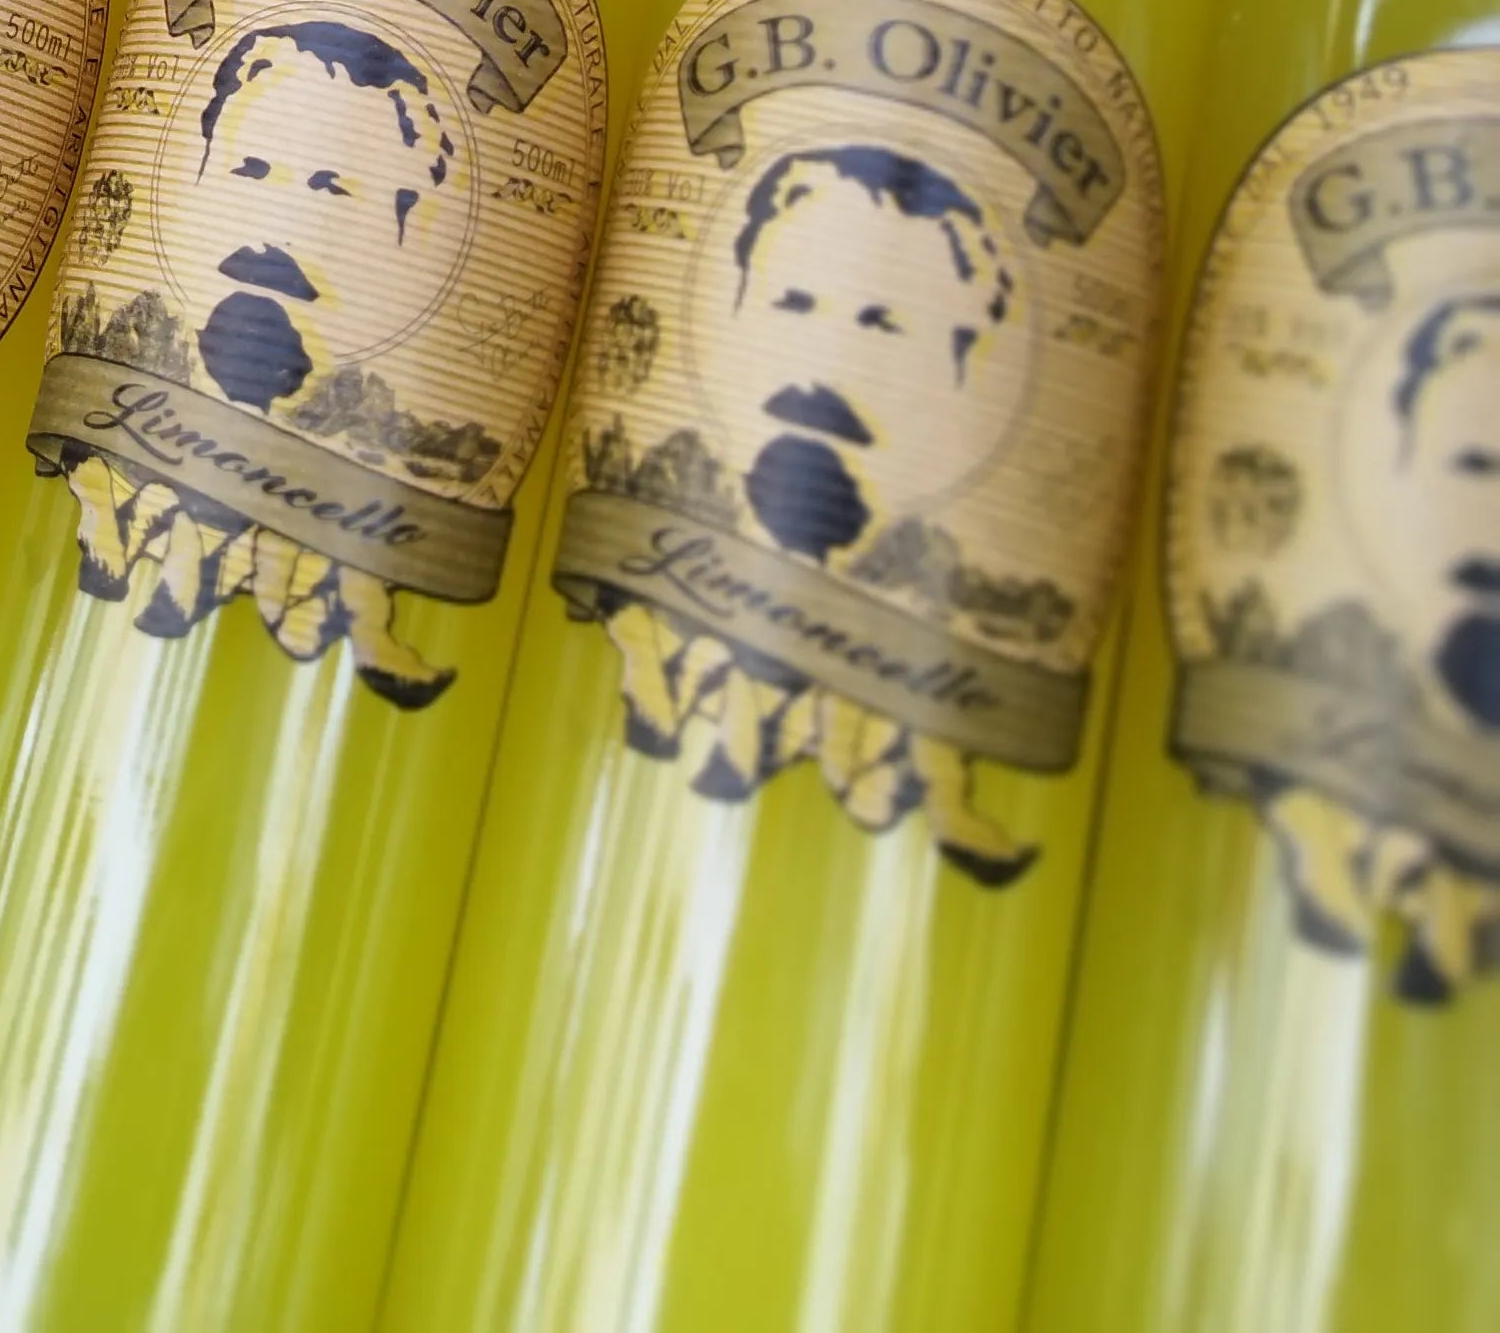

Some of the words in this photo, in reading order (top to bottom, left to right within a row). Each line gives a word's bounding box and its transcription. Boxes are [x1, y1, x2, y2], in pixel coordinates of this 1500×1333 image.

[5, 11, 73, 63] 500ml
[83, 57, 99, 76] E
[652, 18, 692, 75] DAL
[687, 13, 837, 97] G.B.
[868, 18, 1112, 196] Olivier
[1309, 64, 1411, 132] 1949
[512, 138, 576, 186] 500ml
[1304, 144, 1500, 234] G.B.
[82, 382, 426, 546] Limoncello
